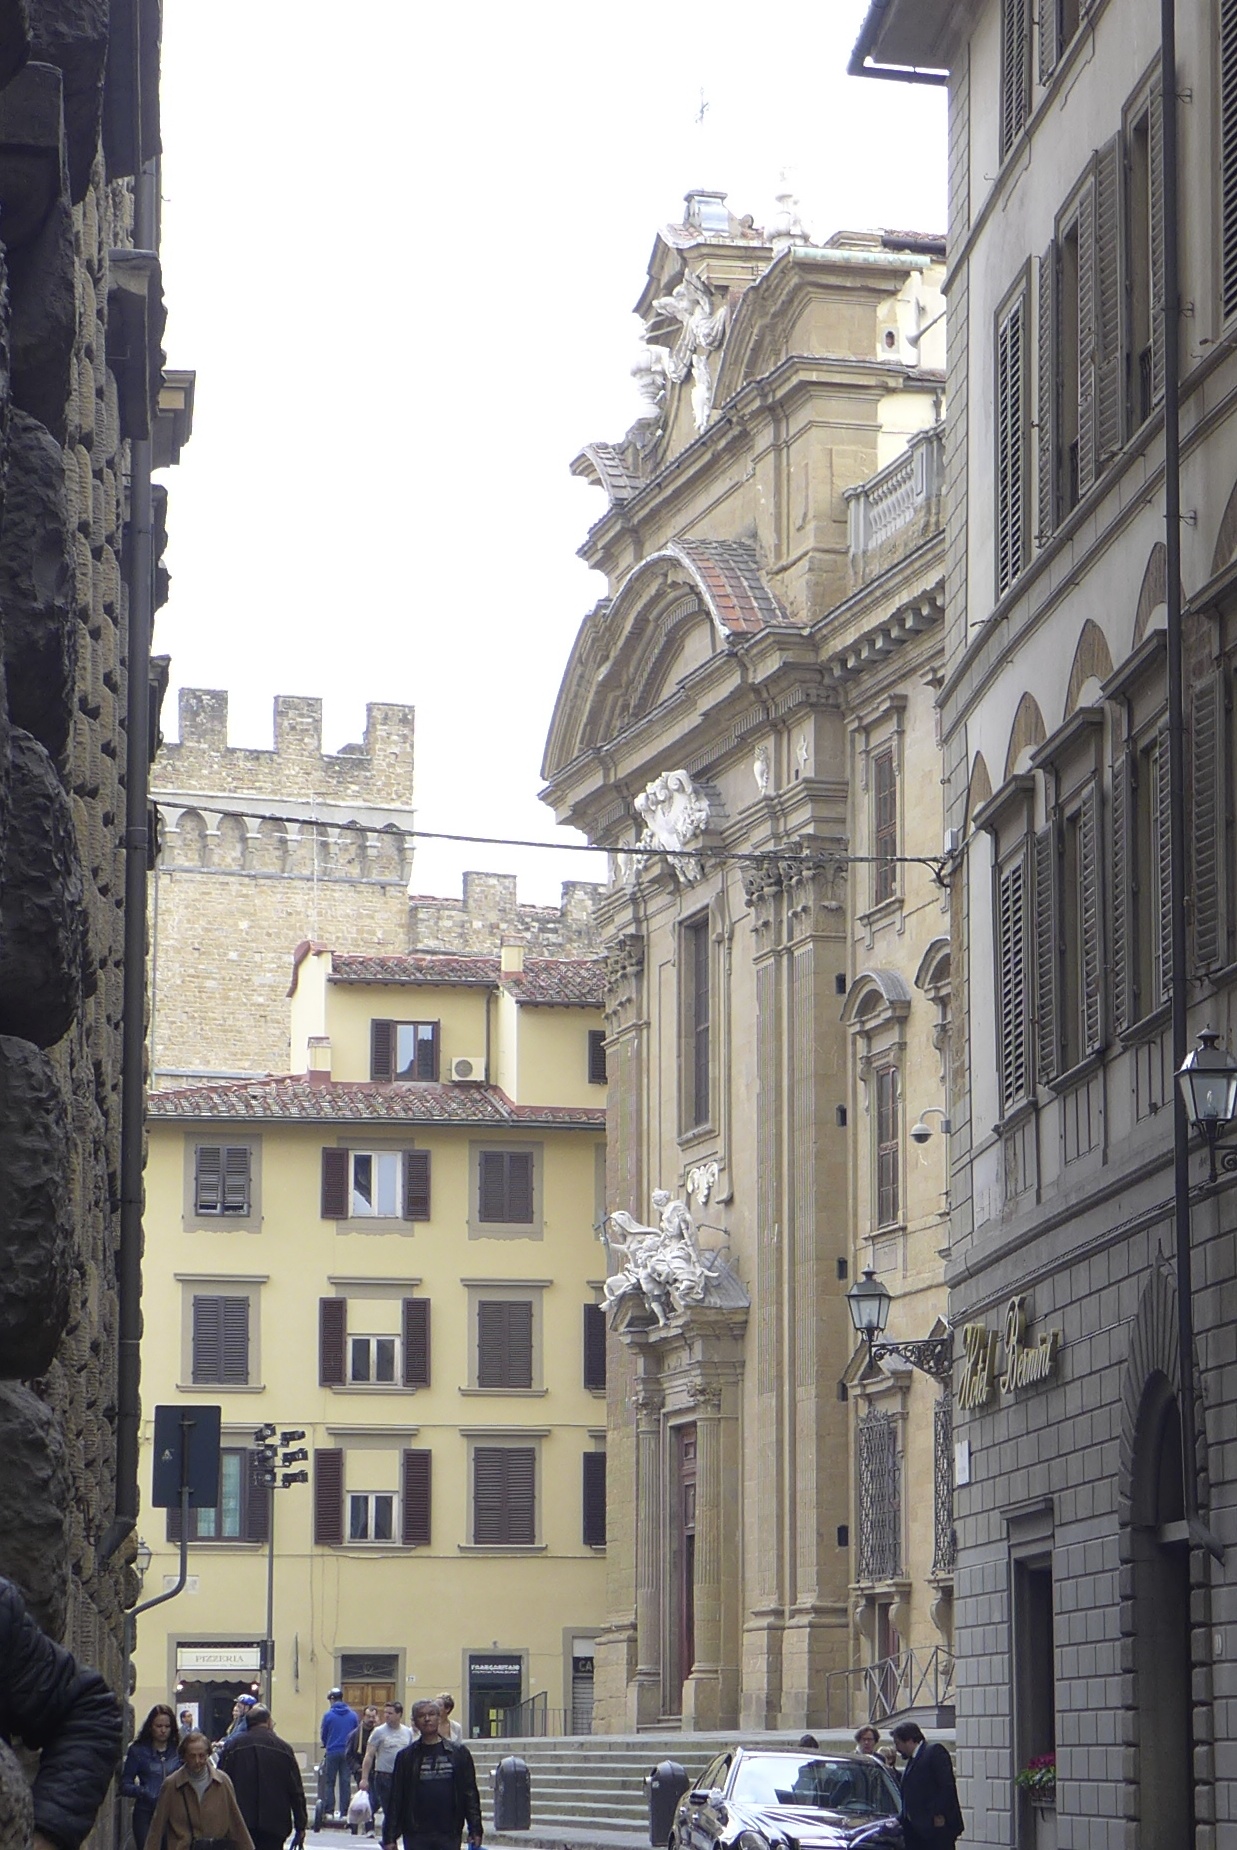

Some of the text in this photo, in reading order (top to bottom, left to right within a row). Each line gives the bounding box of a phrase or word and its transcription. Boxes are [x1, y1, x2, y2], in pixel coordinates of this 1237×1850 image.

[958, 1295, 1060, 1410] Hotel Bernini
[195, 1655, 244, 1663] PIZZERIA
